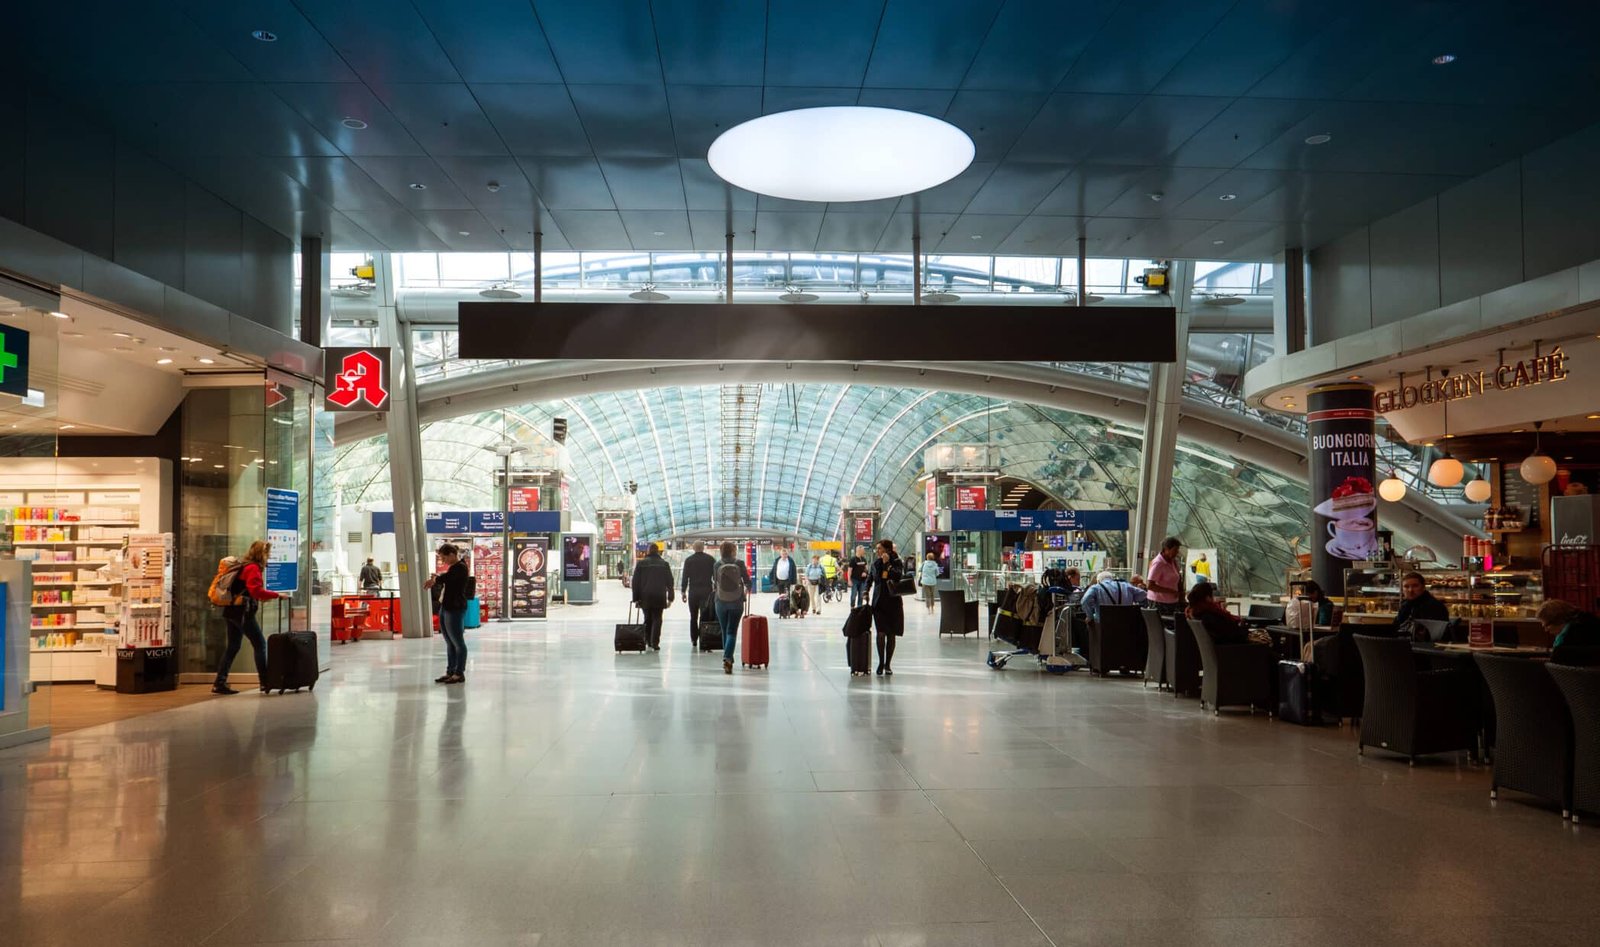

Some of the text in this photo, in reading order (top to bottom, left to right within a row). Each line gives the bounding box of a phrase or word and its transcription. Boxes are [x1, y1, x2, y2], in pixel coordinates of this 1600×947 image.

[1312, 433, 1376, 450] BUONGIORN
[1331, 451, 1370, 467] ITALIA
[1063, 510, 1076, 518] 1-3
[1067, 559, 1084, 567] OGT
[117, 650, 135, 658] VICHY
[145, 648, 175, 657] VICHY
